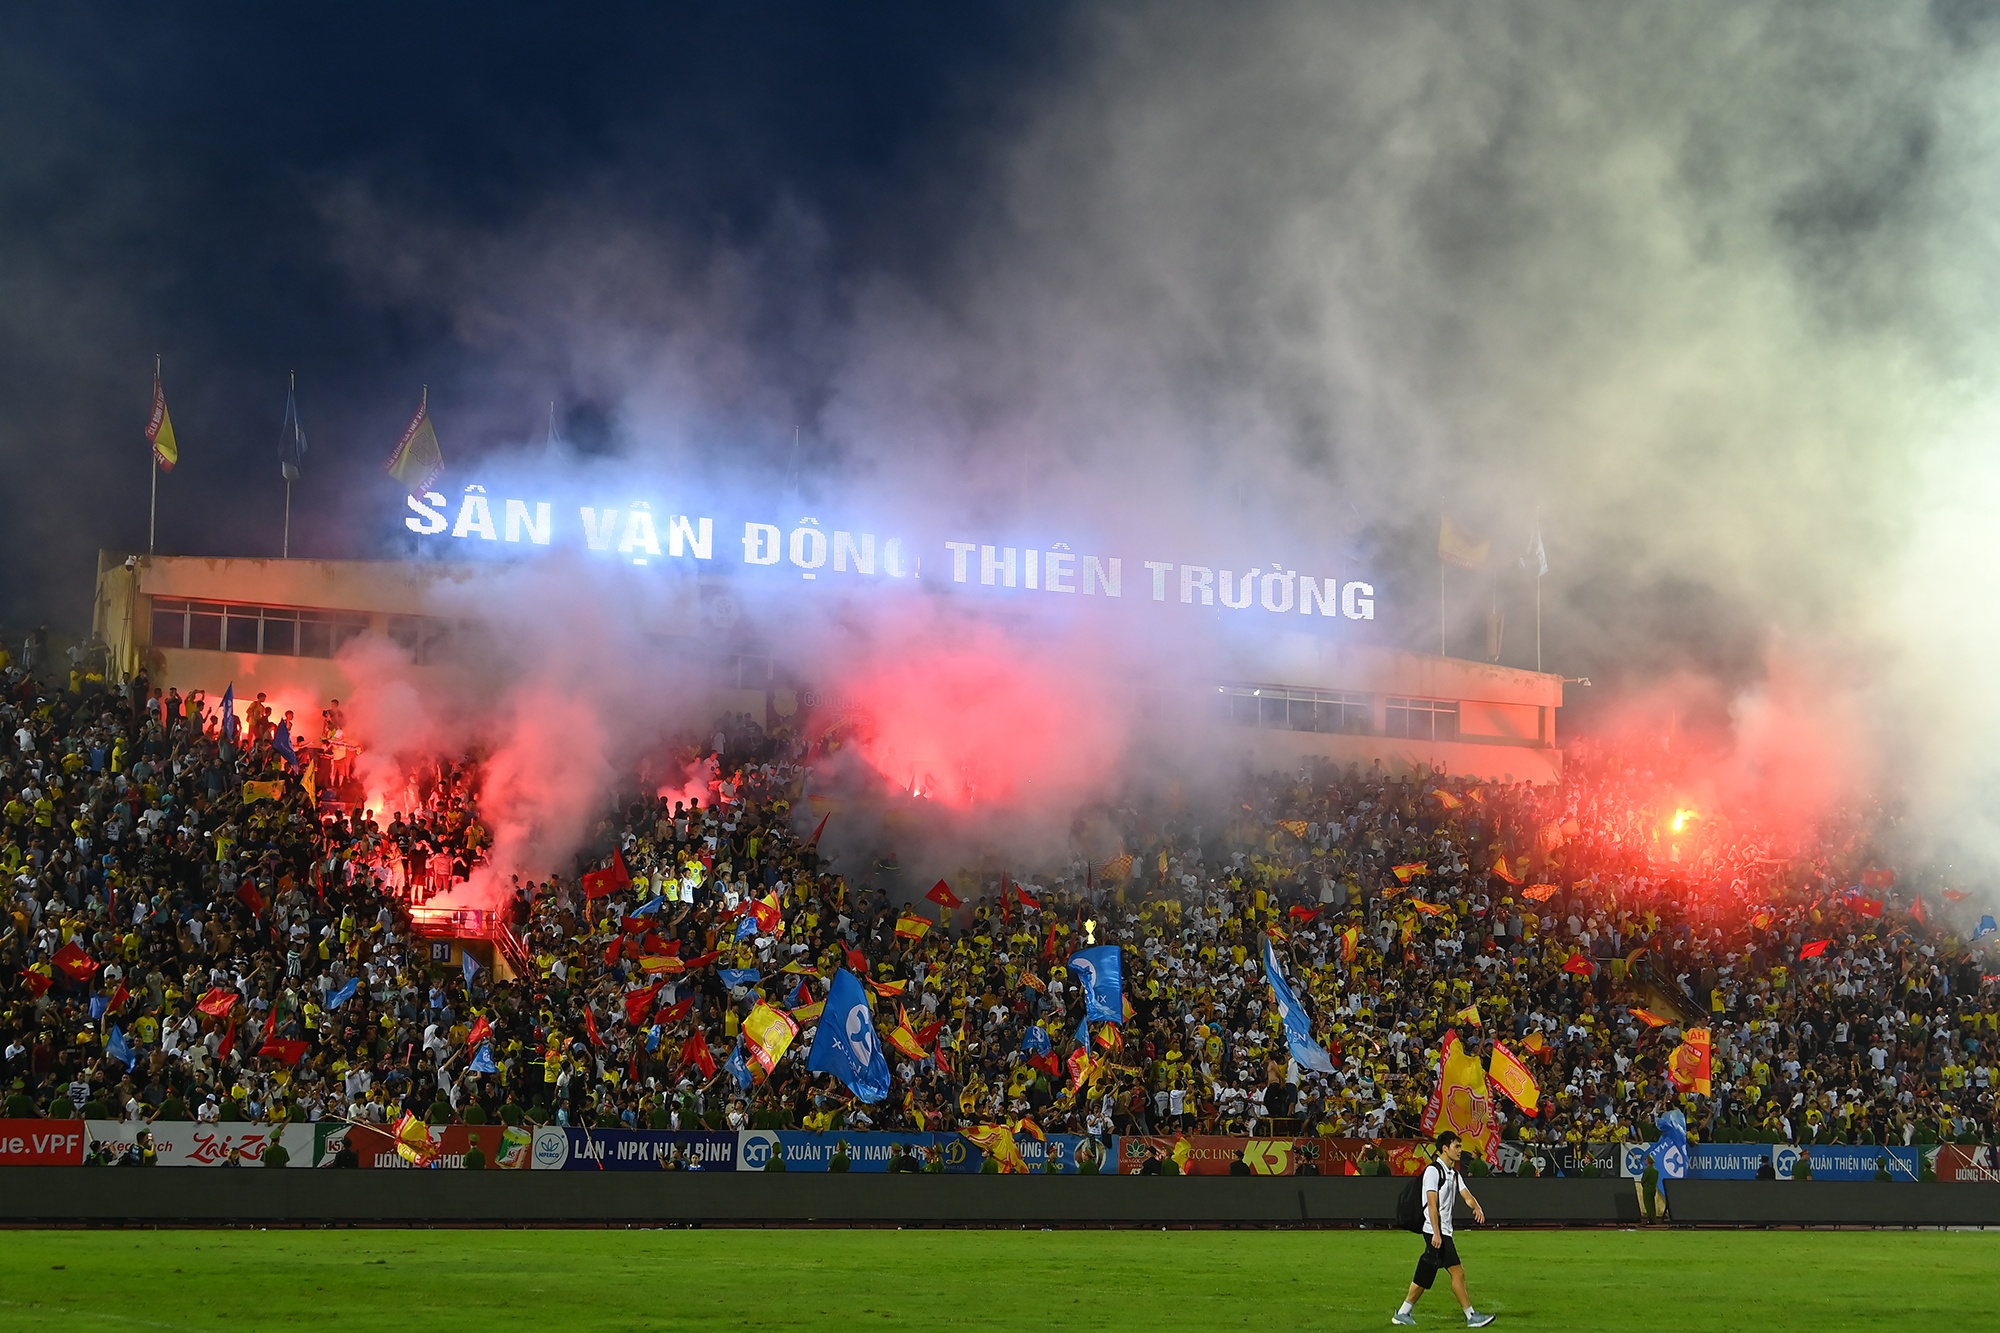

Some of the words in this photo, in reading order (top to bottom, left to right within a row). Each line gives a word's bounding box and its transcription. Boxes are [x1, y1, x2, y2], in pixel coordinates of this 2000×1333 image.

[405, 484, 551, 545] SÂN
[580, 501, 714, 565] VẬN
[945, 542, 1122, 598] THIÊN
[1144, 560, 1375, 620] TRƯỜNG
[432, 944, 449, 960] B1
[617, 1141, 649, 1160] NPK
[695, 1138, 732, 1161] BÌNH
[786, 1142, 821, 1160] XUÂN
[864, 1146, 892, 1160] NAM
[1243, 1140, 1294, 1175] K5
[1564, 1155, 1613, 1172] Engand
[1714, 1154, 1740, 1170] XUÂN
[1742, 1154, 1763, 1170] THIÊ
[1810, 1154, 1832, 1170] XUÂN
[1834, 1154, 1859, 1173] THIỆN
